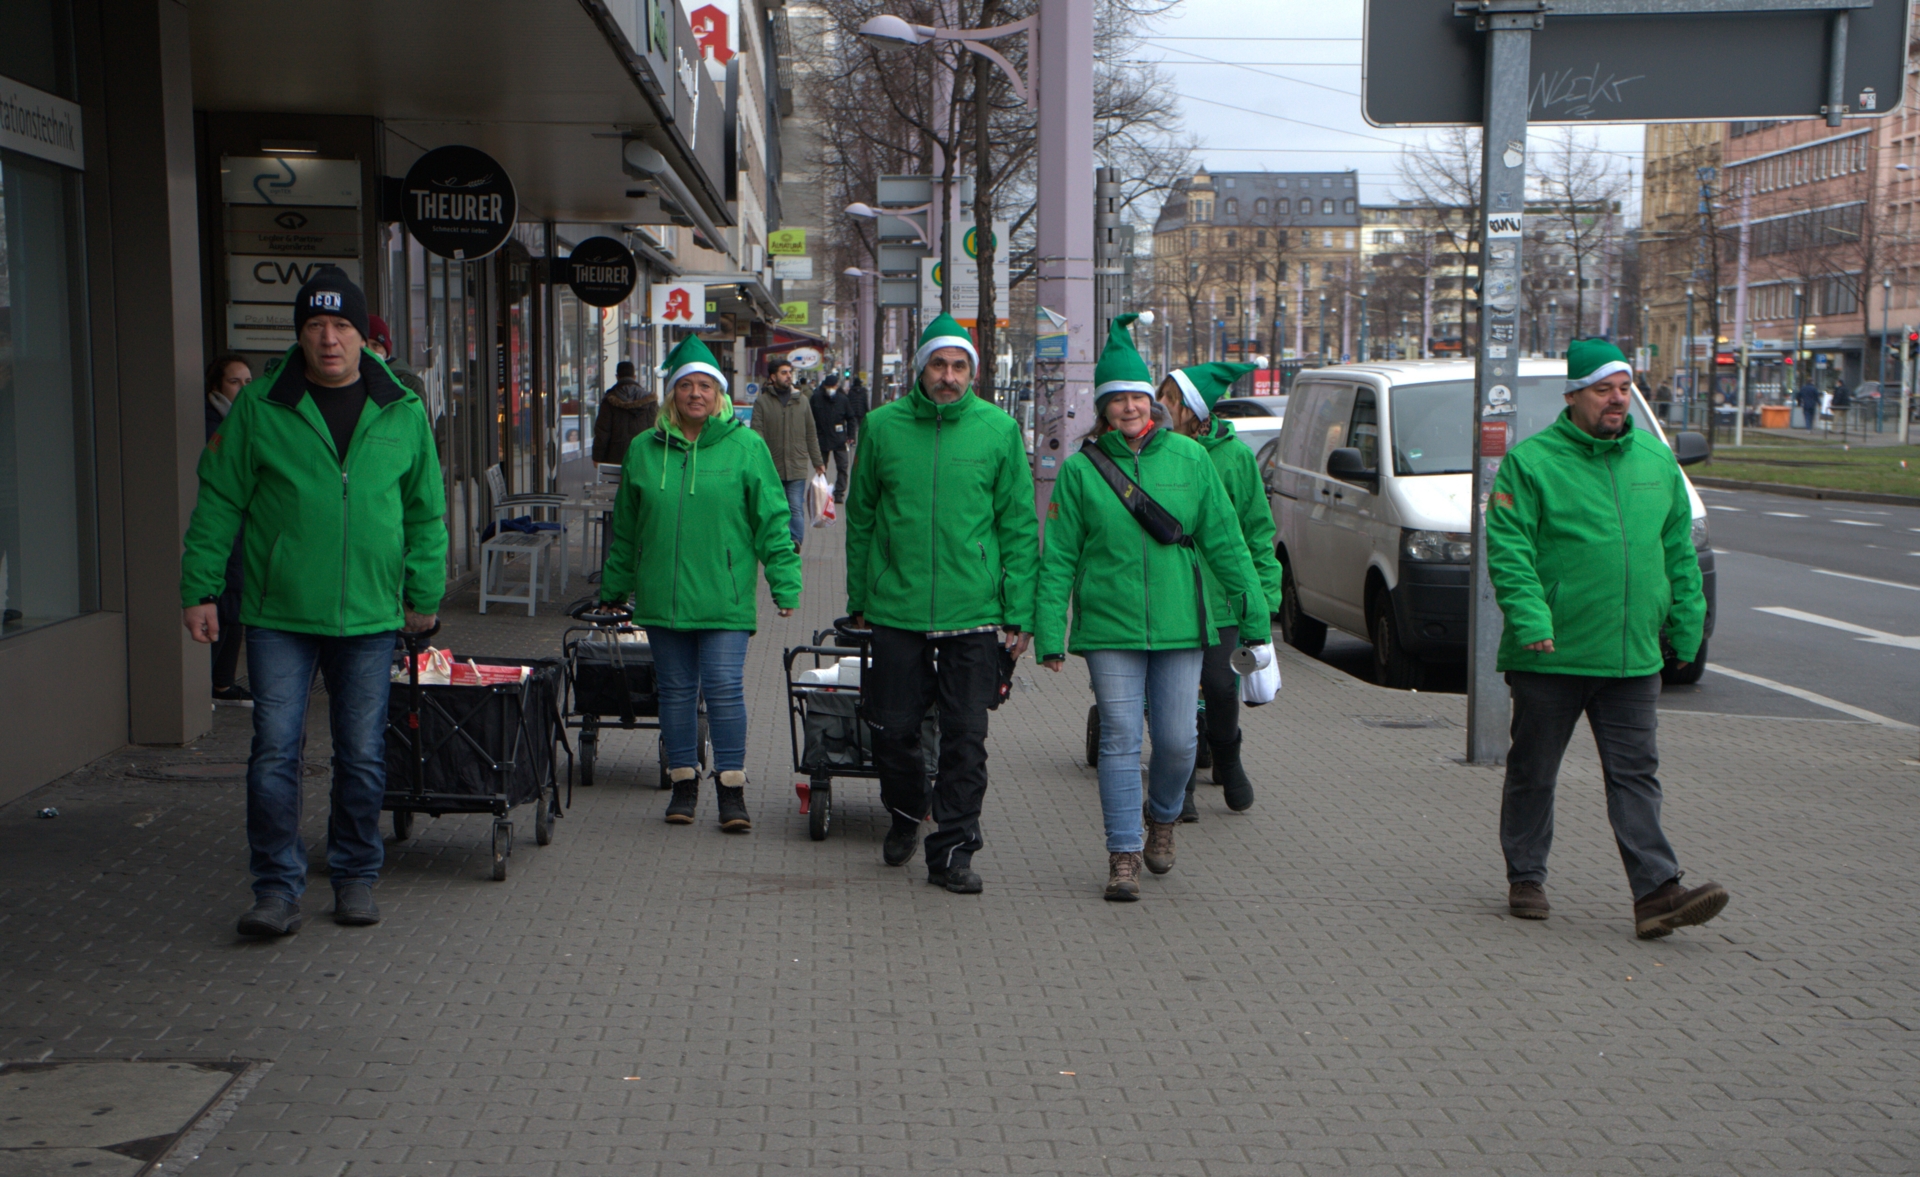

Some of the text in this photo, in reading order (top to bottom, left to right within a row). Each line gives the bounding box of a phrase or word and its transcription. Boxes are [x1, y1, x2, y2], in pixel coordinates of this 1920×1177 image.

[410, 189, 504, 224] THEURER
[432, 225, 459, 233] Schmeckt
[269, 243, 316, 251] Augenärzte
[253, 261, 336, 285] CW
[572, 264, 629, 286] THEURER
[309, 294, 341, 307] ICON
